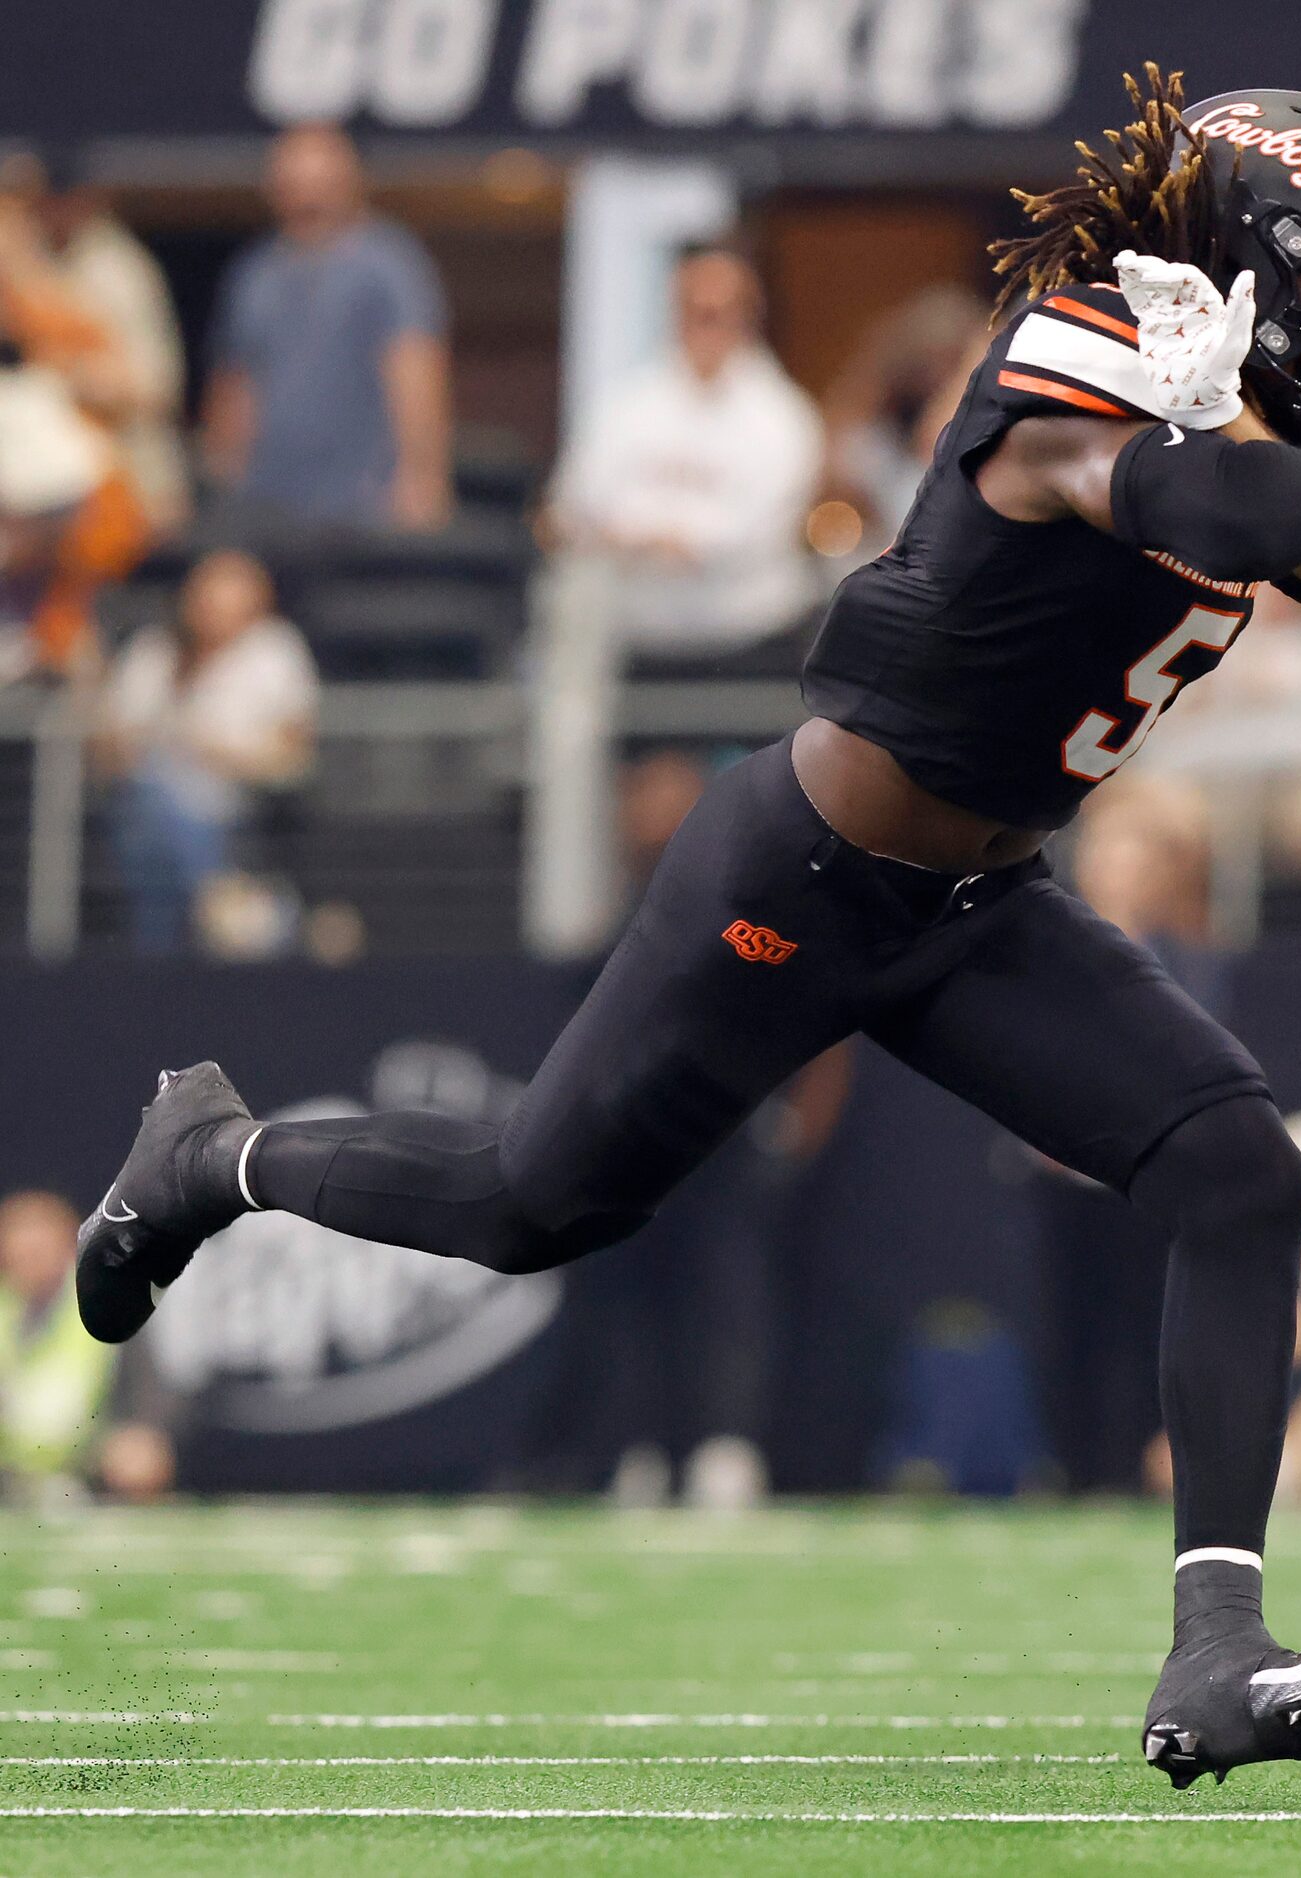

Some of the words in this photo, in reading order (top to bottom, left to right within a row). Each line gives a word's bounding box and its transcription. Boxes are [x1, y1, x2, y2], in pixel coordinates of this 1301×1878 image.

[247, 0, 497, 124] GO
[1060, 602, 1246, 783] 5
[721, 919, 799, 965] OSU
